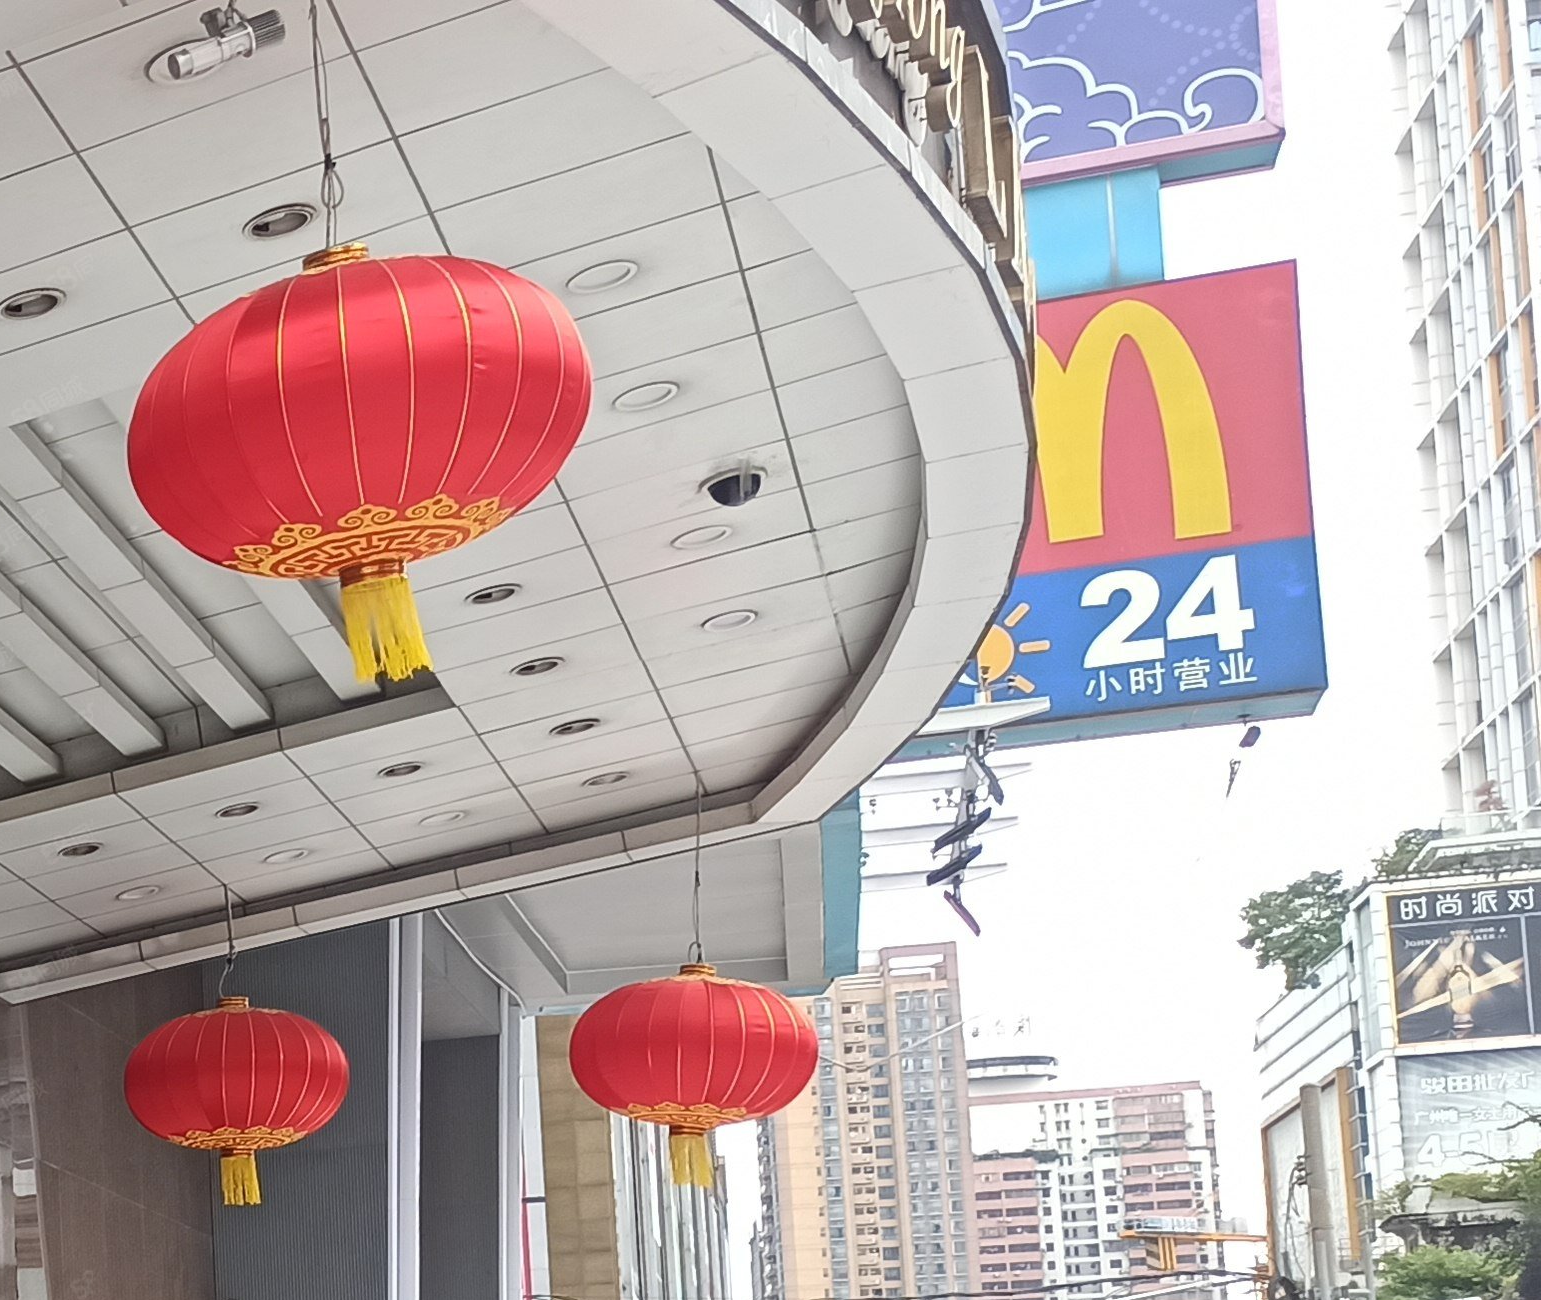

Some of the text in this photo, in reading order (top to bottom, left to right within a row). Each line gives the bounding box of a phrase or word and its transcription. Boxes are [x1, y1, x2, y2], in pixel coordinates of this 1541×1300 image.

[1081, 555, 1255, 670] 24
[1086, 653, 1258, 703] 小时营业
[1400, 886, 1535, 921] 时尚派对
